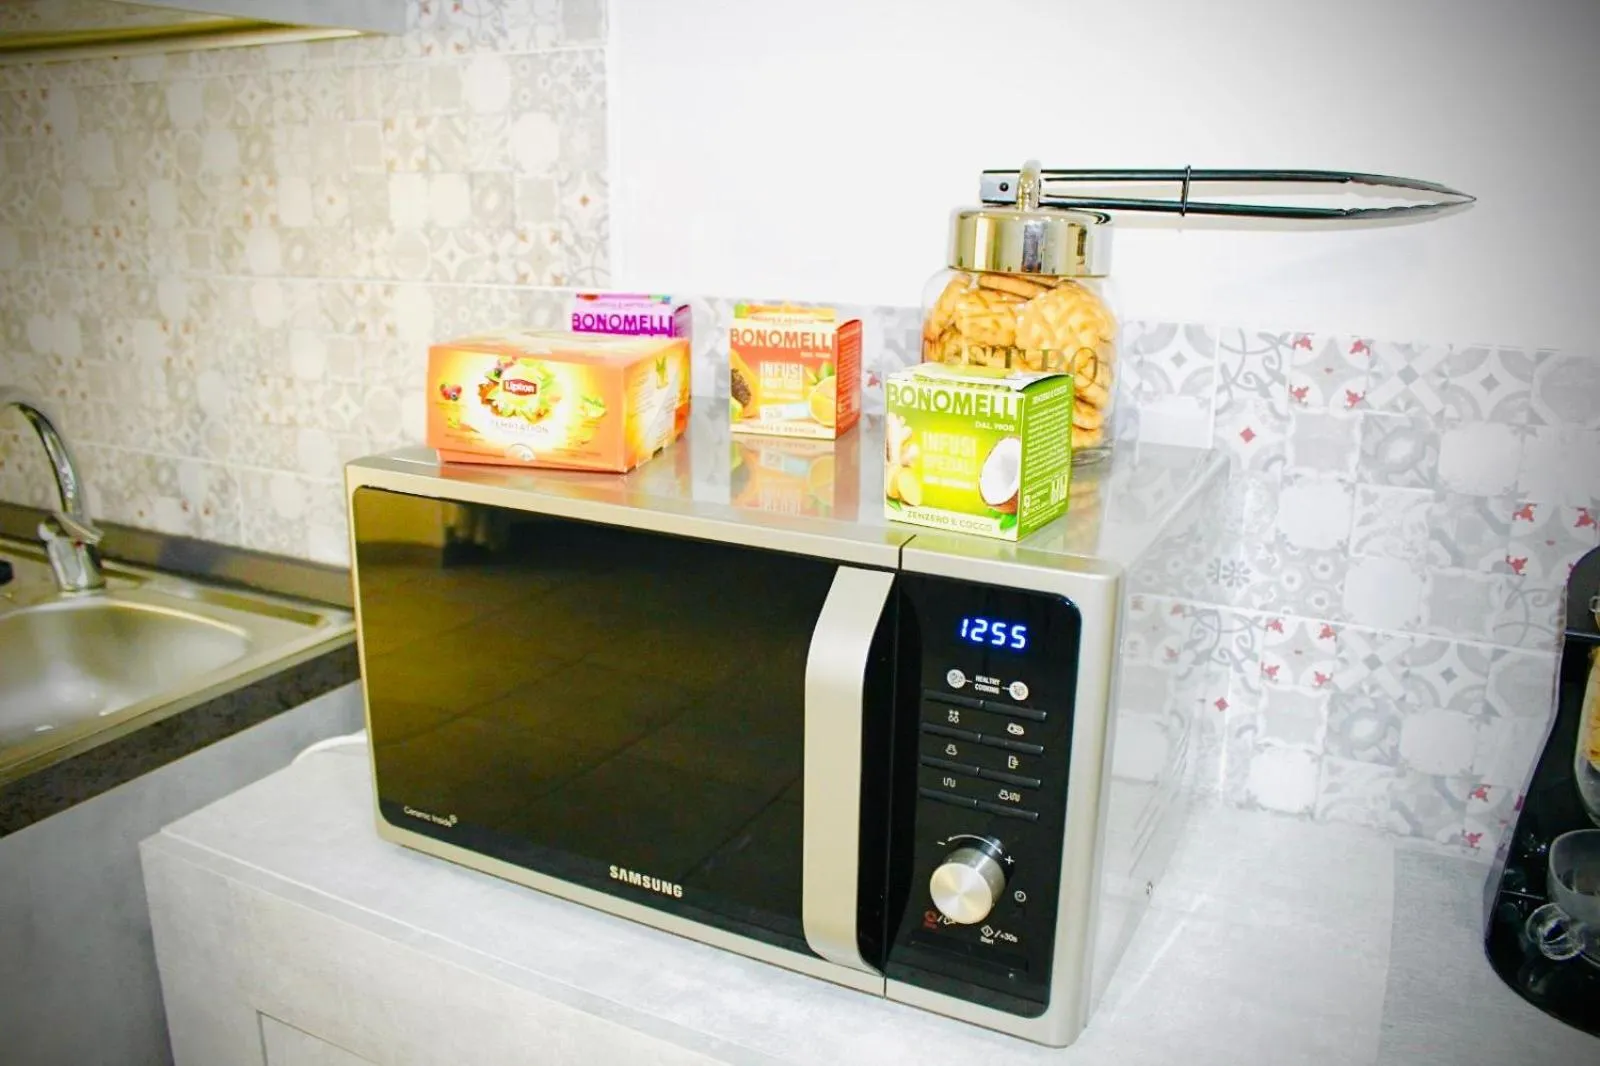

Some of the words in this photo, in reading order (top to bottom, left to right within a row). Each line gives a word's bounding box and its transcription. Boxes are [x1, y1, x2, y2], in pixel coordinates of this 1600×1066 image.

[572, 313, 673, 335] BONOMELLI
[730, 328, 838, 350] BONOMELLI
[505, 381, 535, 393] Lipton
[886, 383, 1023, 419] BONOMELLI
[907, 511, 950, 524] ZENZERO
[959, 519, 993, 531] COCCO
[961, 618, 1026, 649] 1255
[609, 865, 683, 898] SAMSUNG
